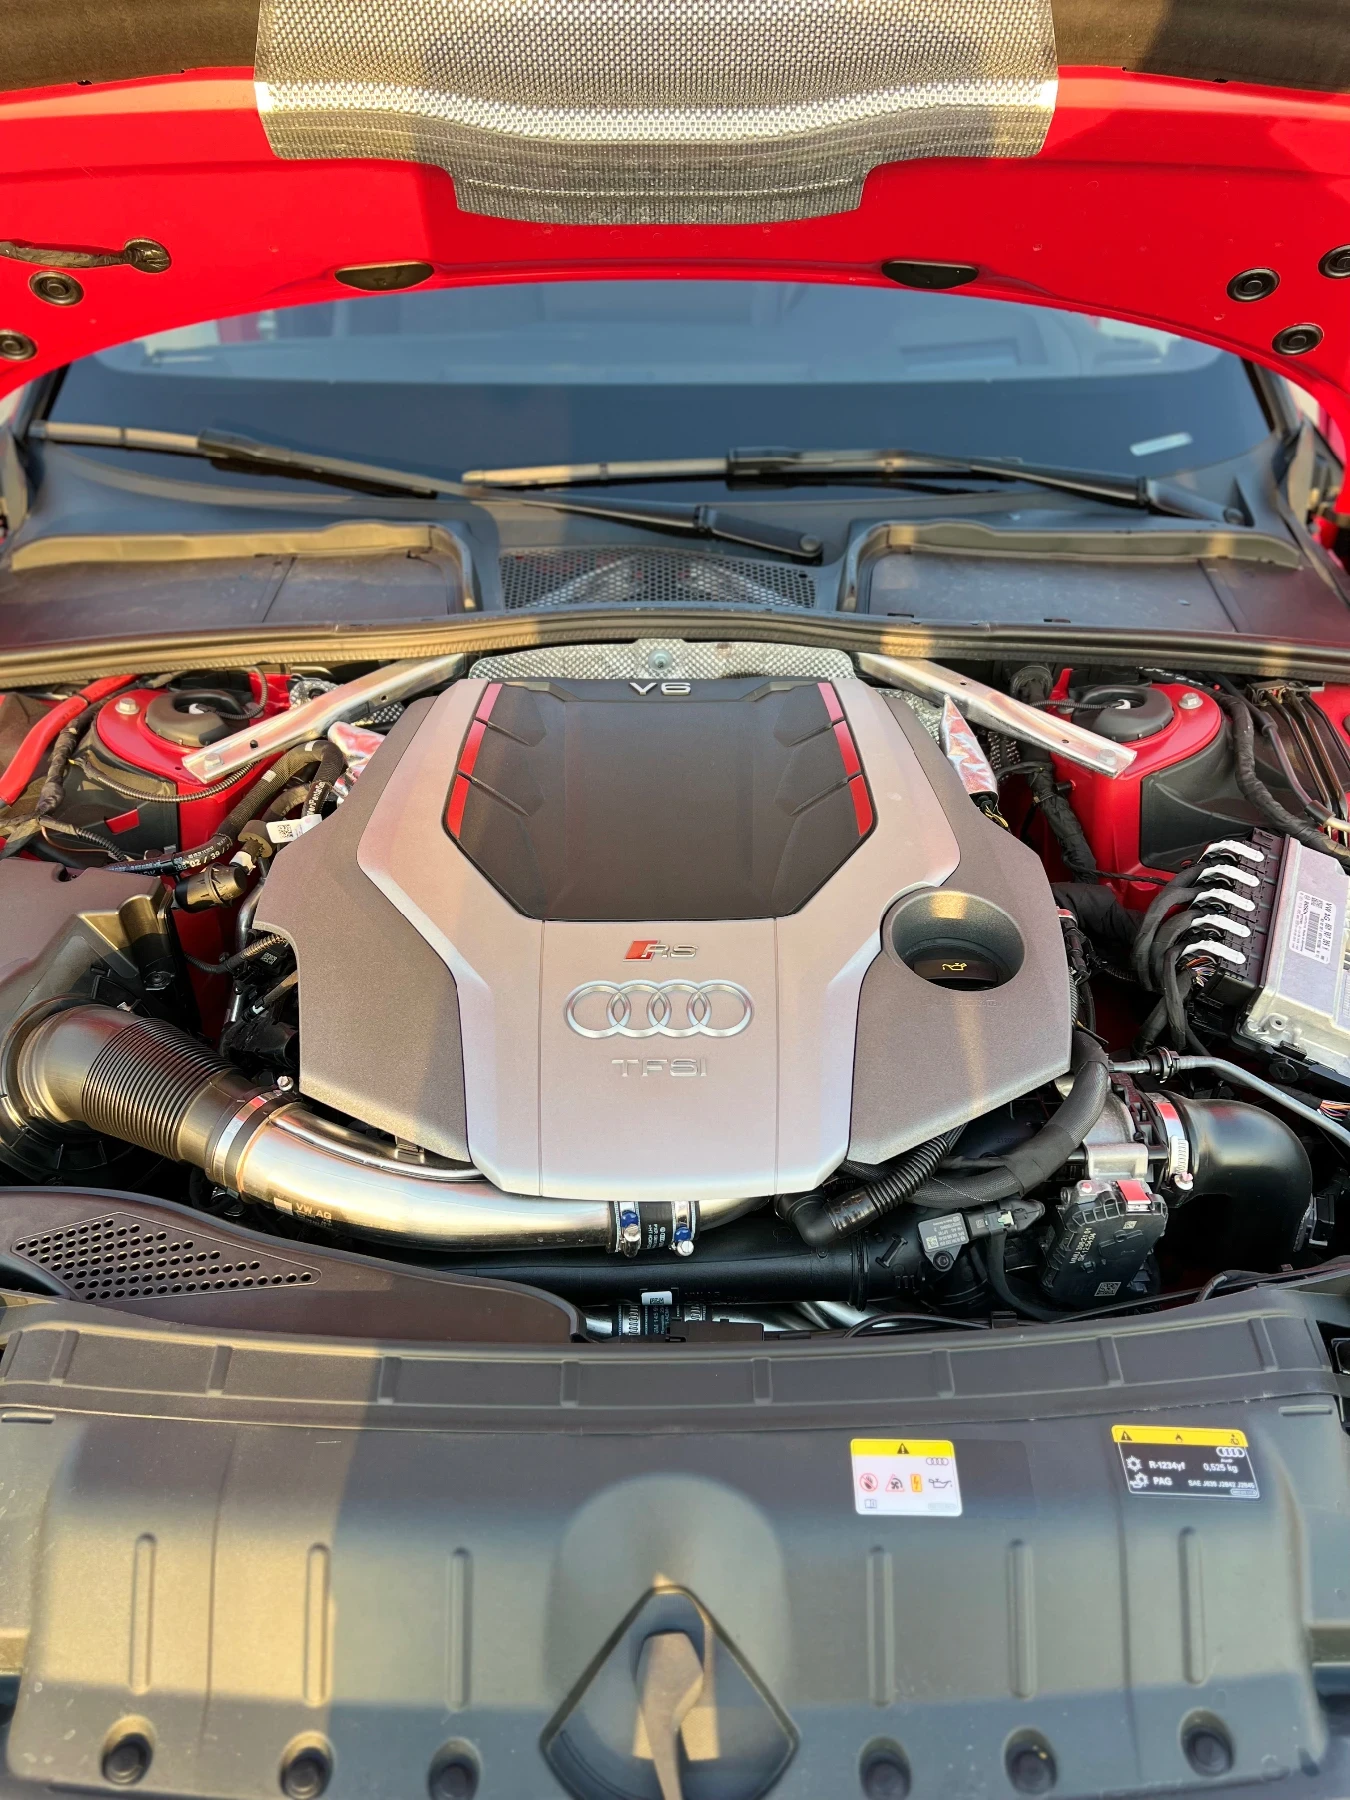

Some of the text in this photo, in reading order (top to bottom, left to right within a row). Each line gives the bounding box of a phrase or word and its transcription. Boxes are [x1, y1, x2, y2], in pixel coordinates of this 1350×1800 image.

[628, 682, 691, 696] V6
[640, 942, 698, 958] RS
[611, 1058, 707, 1077] TFSI
[296, 1202, 332, 1220] VW AG
[1148, 1460, 1239, 1474] R-1234yf 0,525 kg
[1152, 1476, 1173, 1486] PAG
